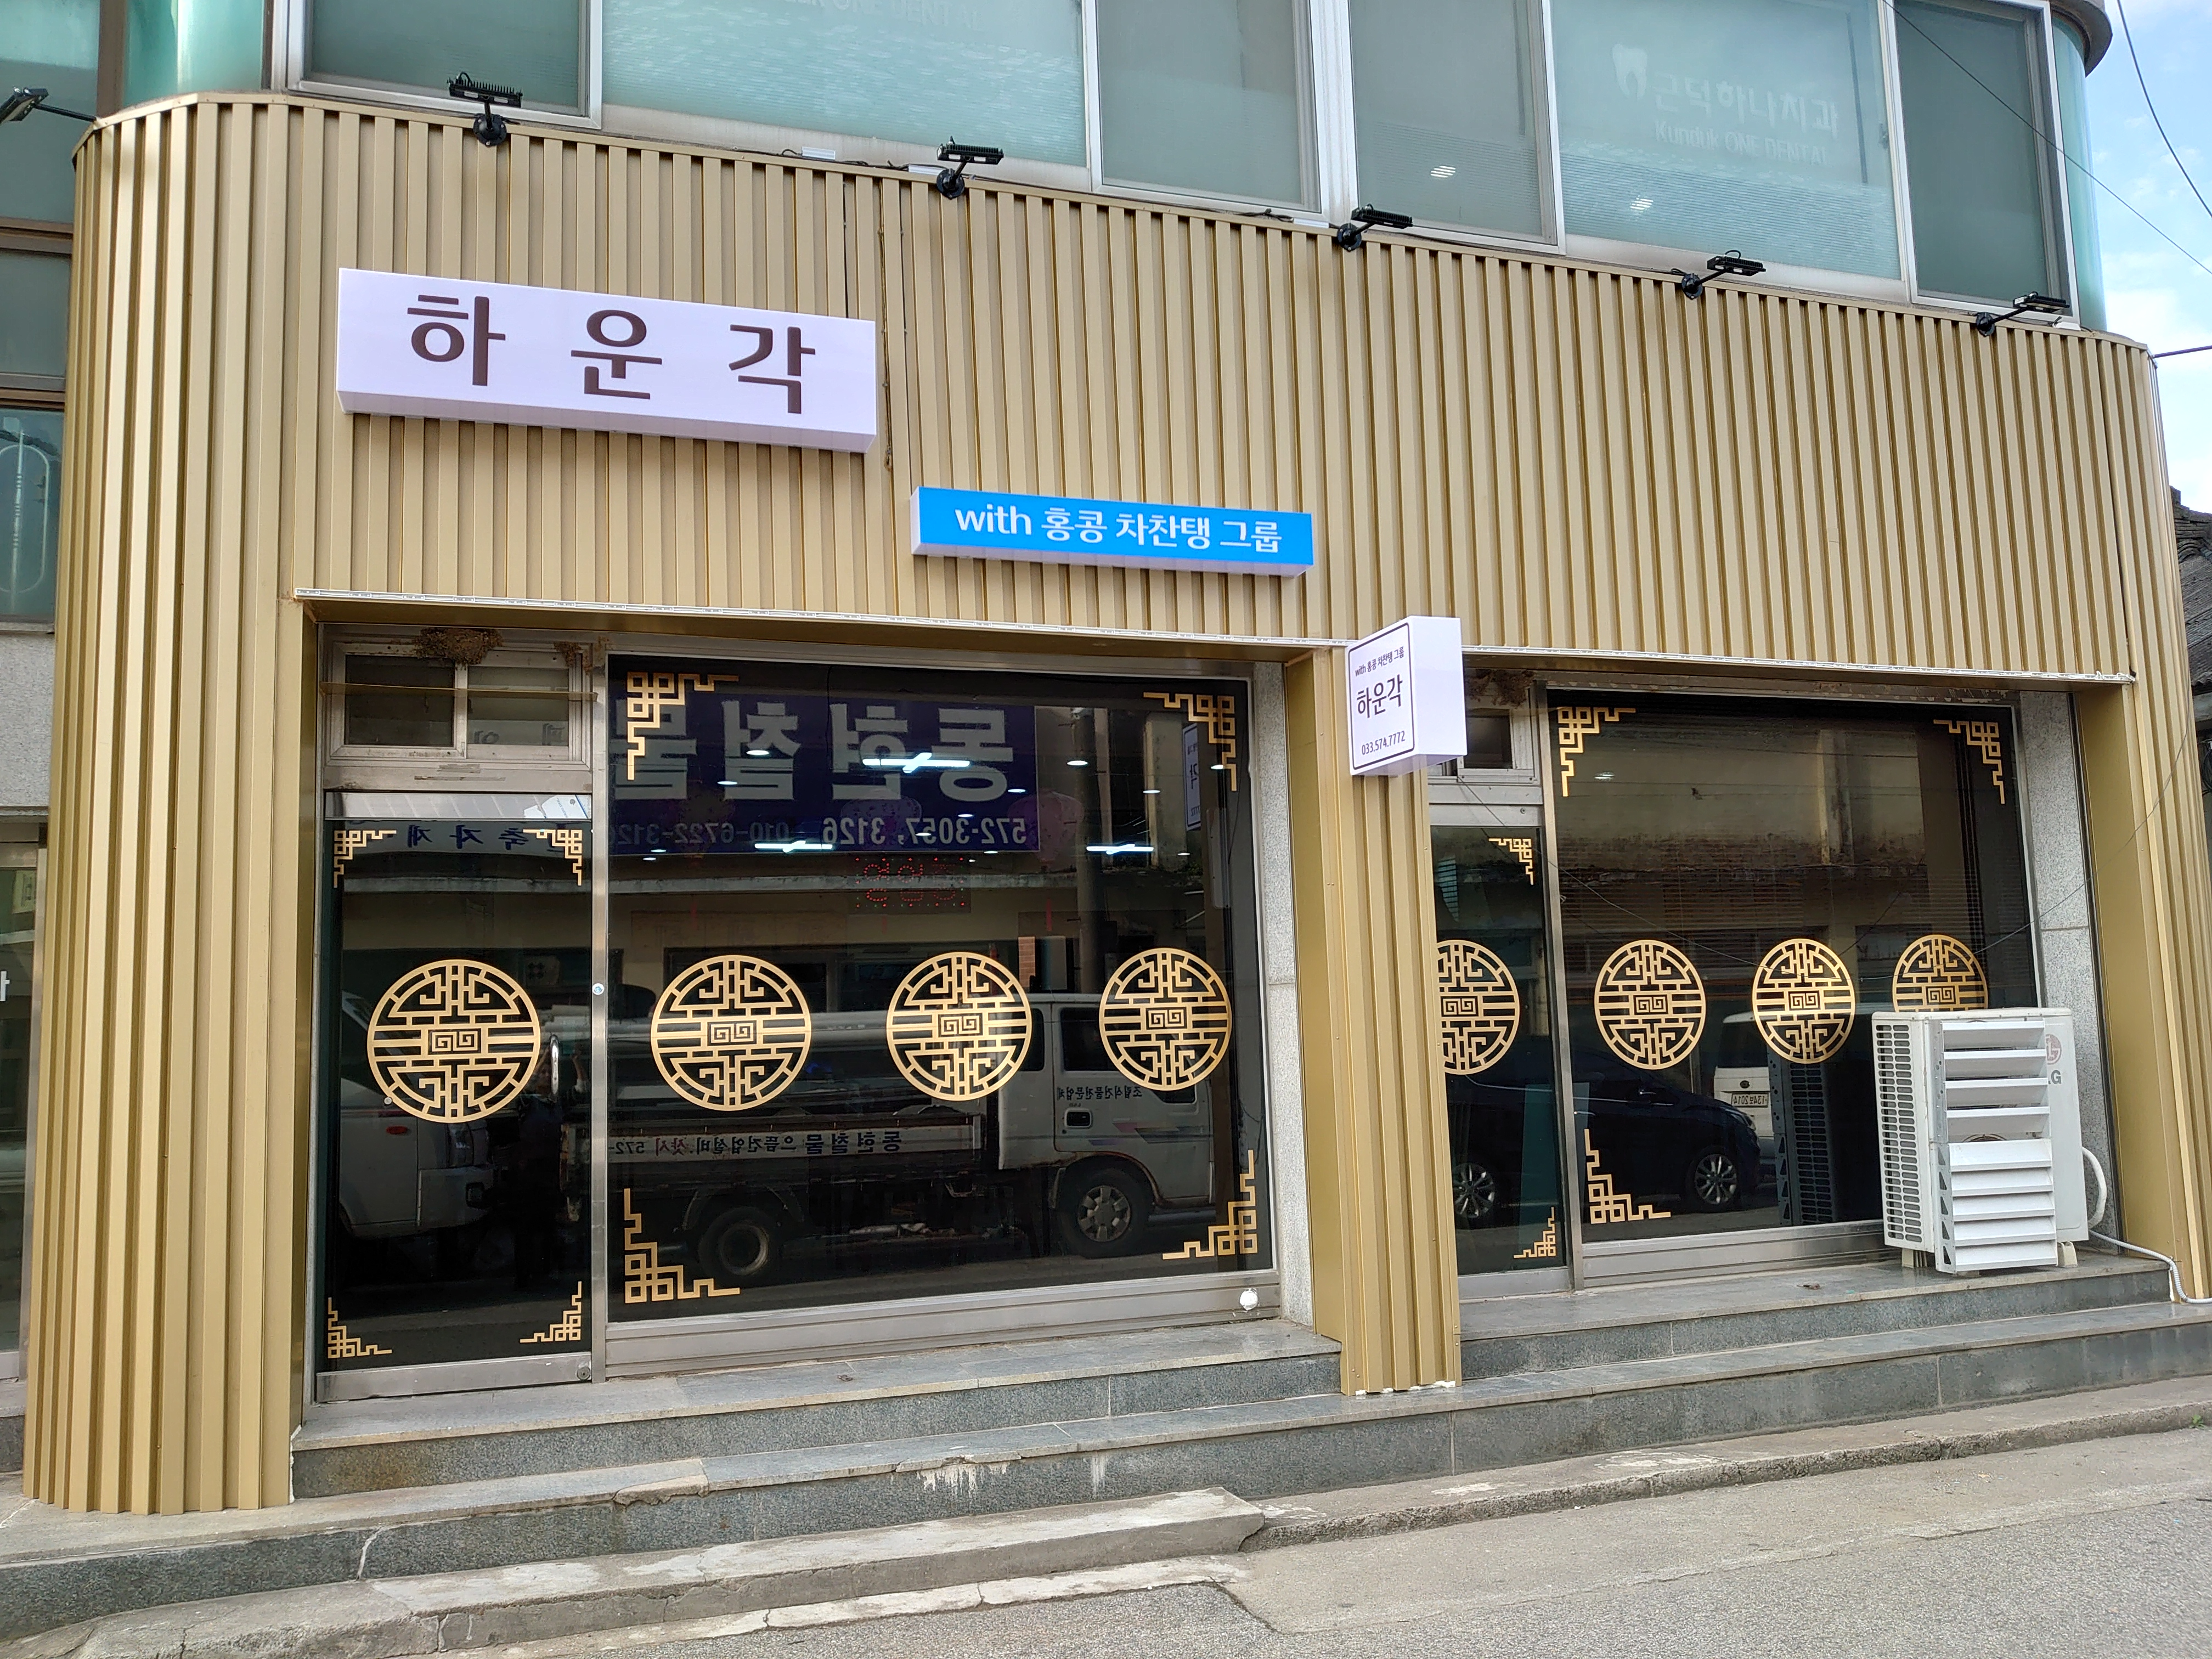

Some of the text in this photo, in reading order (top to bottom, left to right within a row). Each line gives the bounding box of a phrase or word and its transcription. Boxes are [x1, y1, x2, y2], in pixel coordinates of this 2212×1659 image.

[1724, 132, 1761, 159] ONE
[407, 294, 816, 414] 하운각
[955, 503, 1283, 554] with 홍콩 차찬탱 그룹
[1355, 646, 1404, 677] with 홍콩 차찬탱 그룹
[1357, 674, 1403, 719] 하운각
[1362, 730, 1406, 755] 033.574.7772
[2047, 1070, 2062, 1085] G
